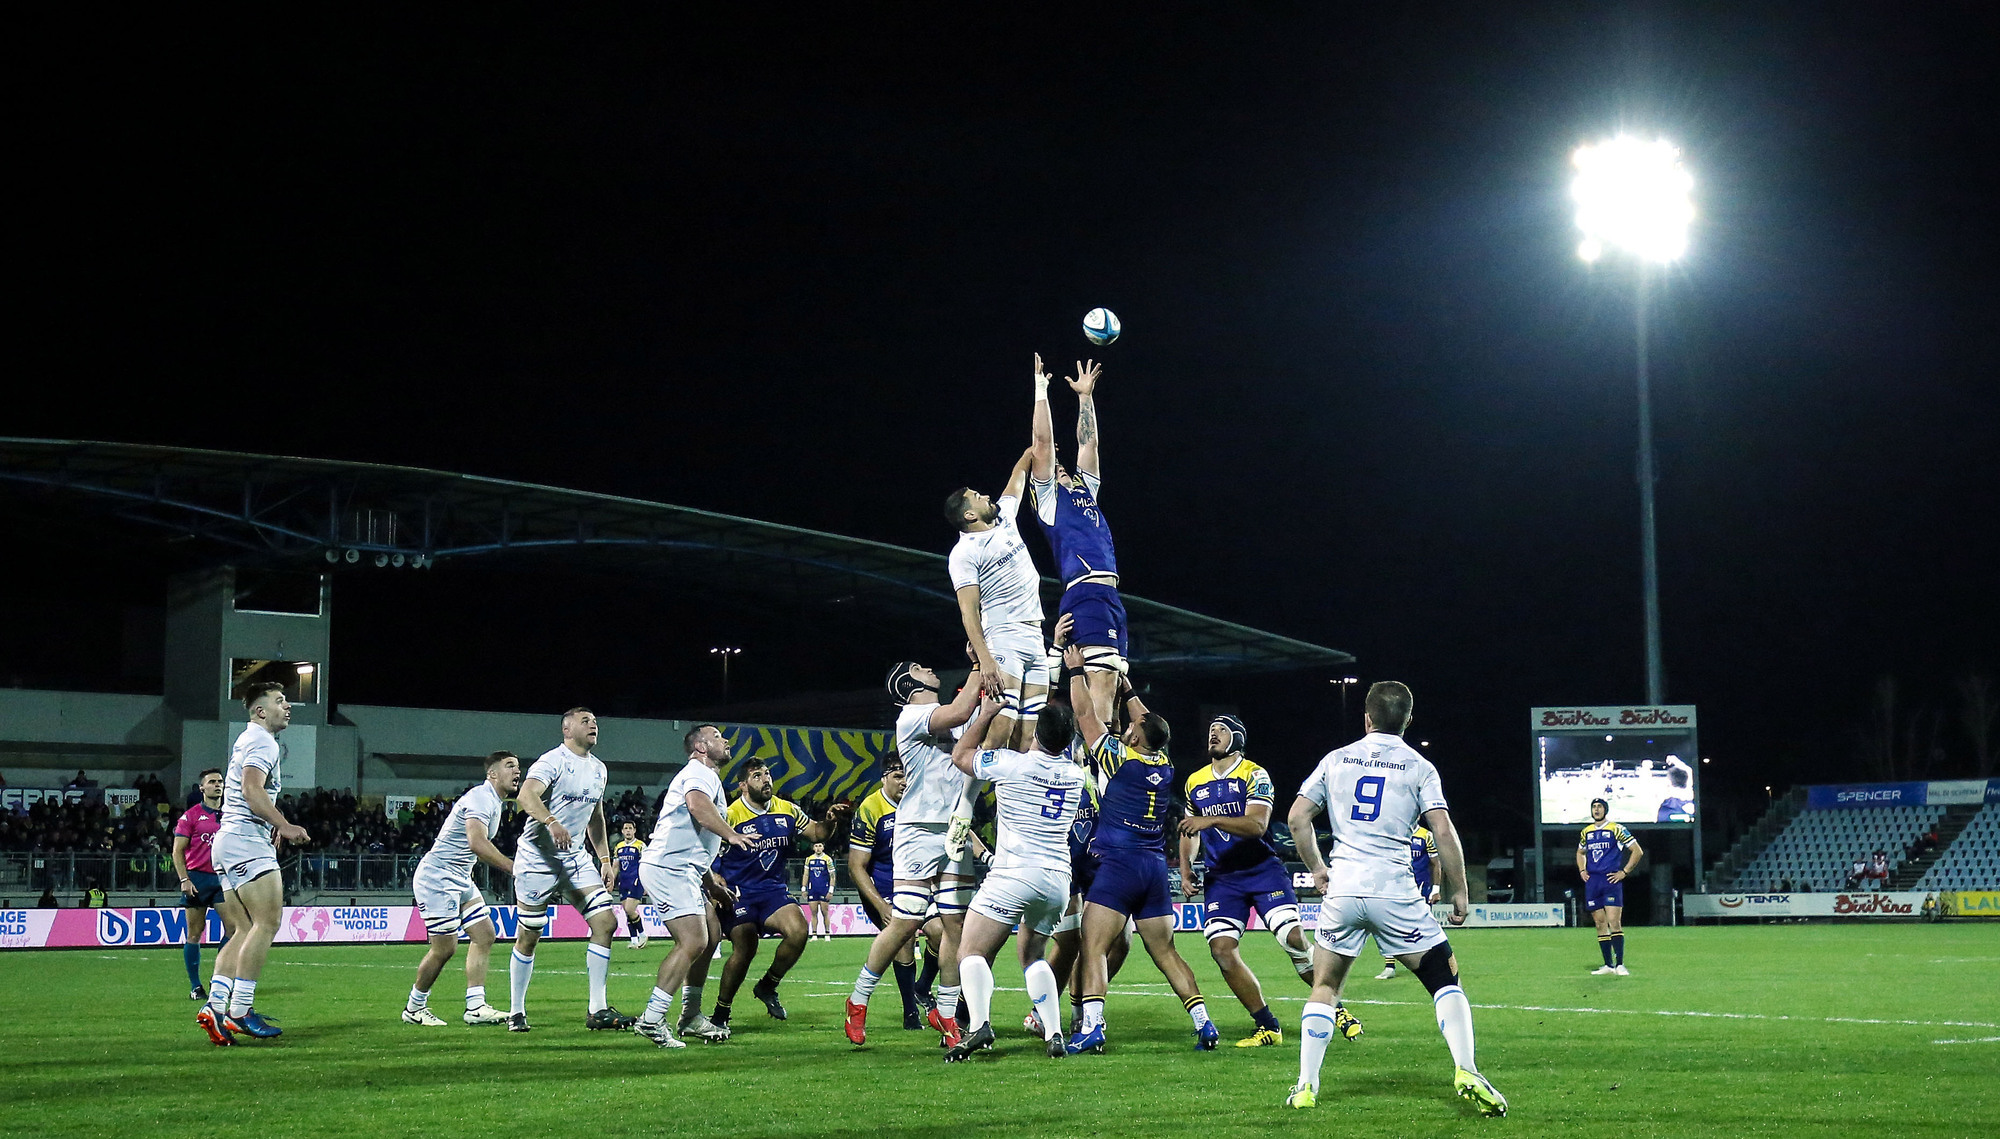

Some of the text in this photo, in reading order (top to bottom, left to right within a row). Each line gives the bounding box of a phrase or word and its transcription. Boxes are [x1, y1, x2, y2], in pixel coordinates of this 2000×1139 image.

[1343, 757, 1406, 771] Bank of Ireland
[1351, 776, 1386, 822] 9
[1837, 790, 1902, 802] SPENCER
[1041, 788, 1066, 820] 3
[1143, 790, 1157, 820] 1
[1202, 801, 1242, 817] AMORETTI
[1745, 895, 1790, 903] TENAX
[333, 908, 388, 919] CHANGE
[1490, 911, 1549, 920] EMILIA ROMAGNA
[344, 920, 388, 930] WORLD
